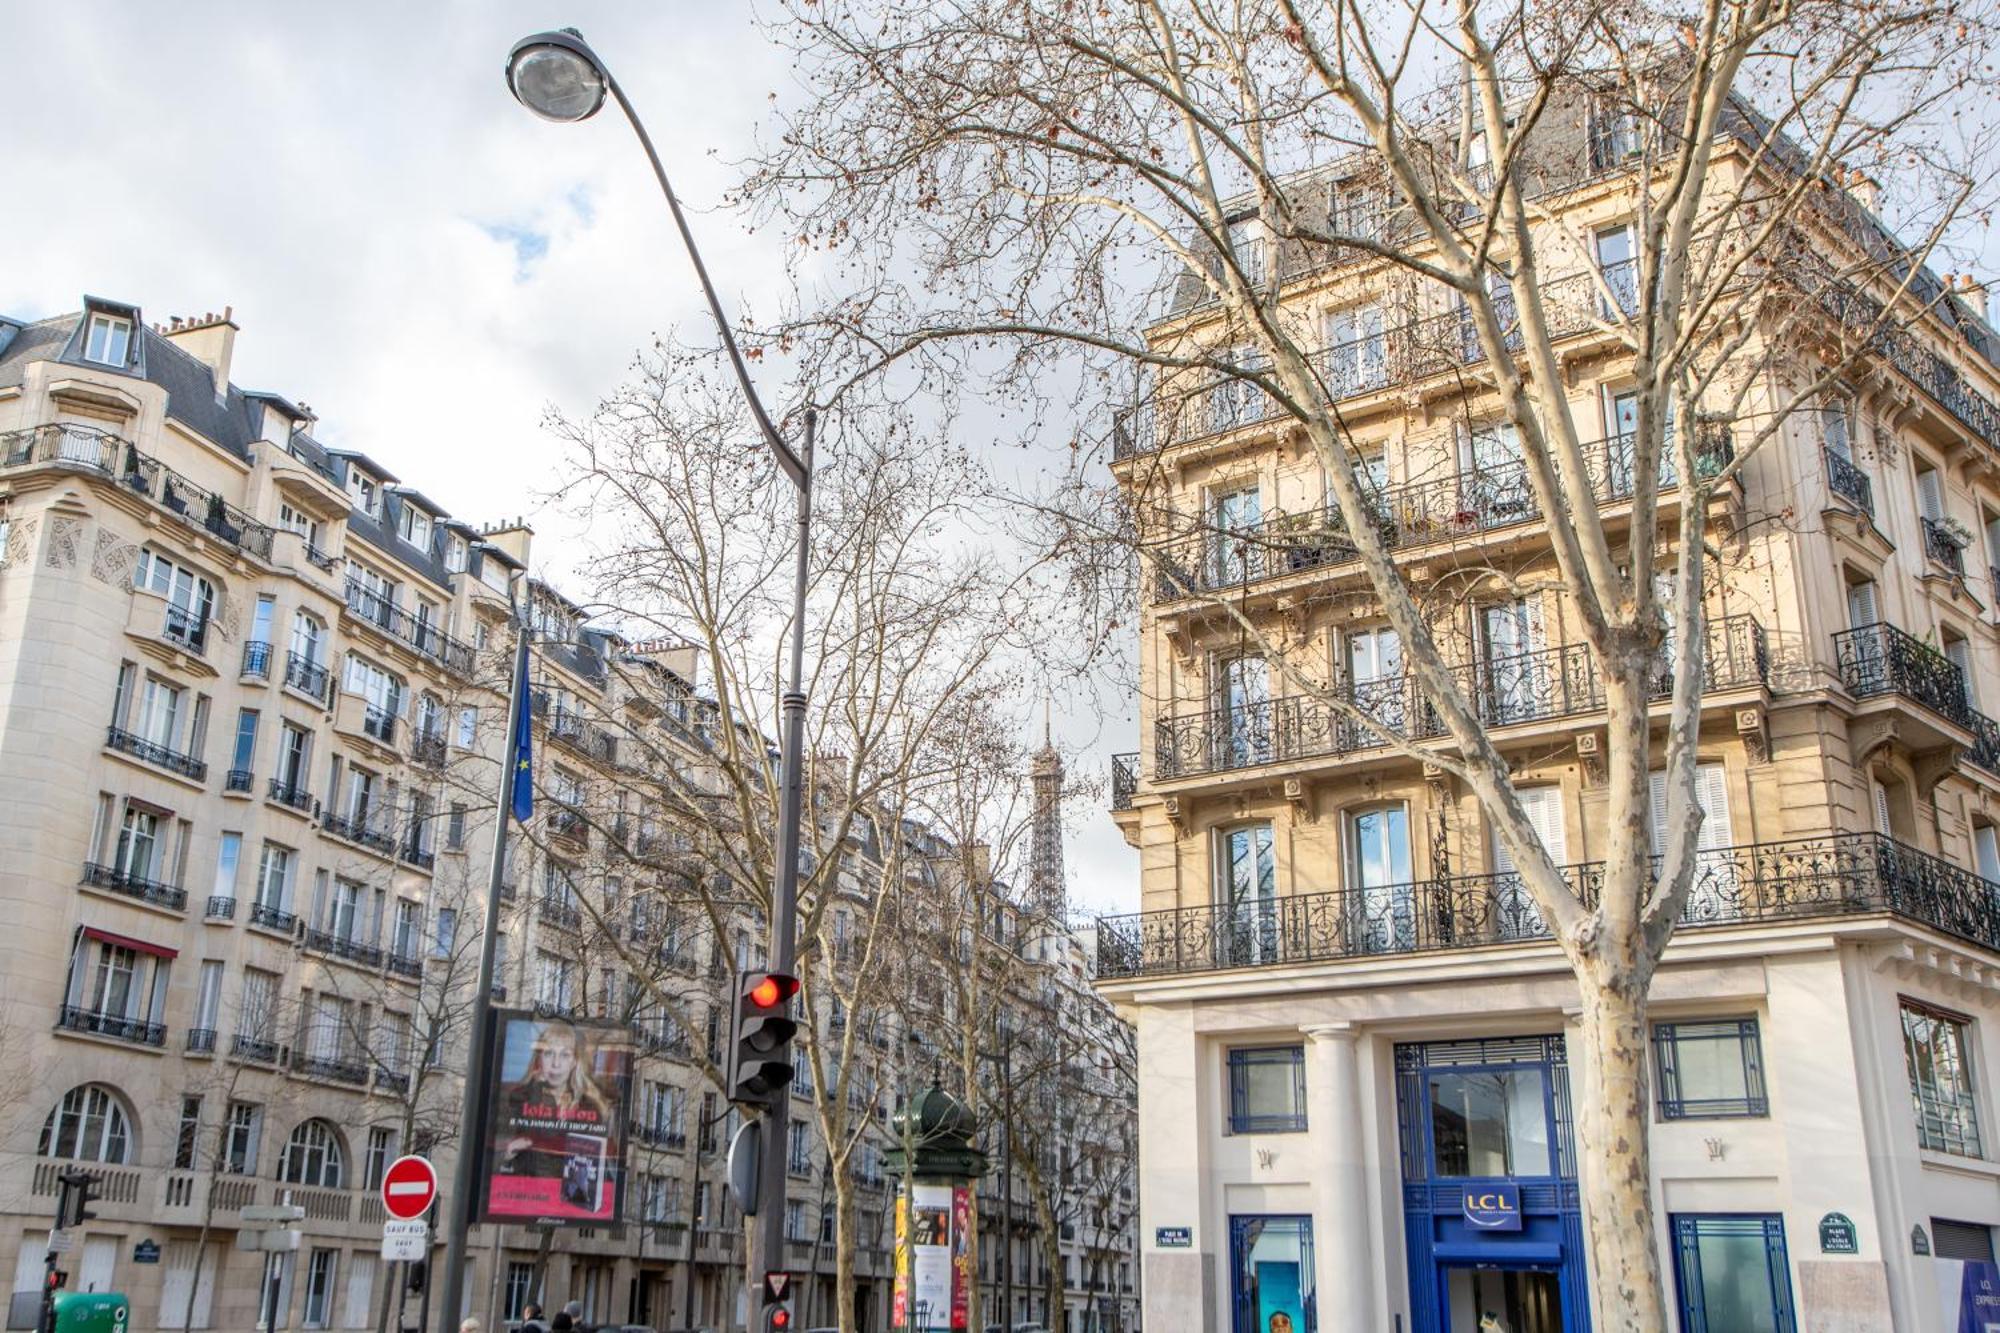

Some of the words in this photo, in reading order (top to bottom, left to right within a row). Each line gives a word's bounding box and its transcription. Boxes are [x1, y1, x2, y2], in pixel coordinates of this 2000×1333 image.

[1467, 1194, 1512, 1210] LCL
[387, 1225, 405, 1233] SAUF
[409, 1225, 425, 1233] BUS
